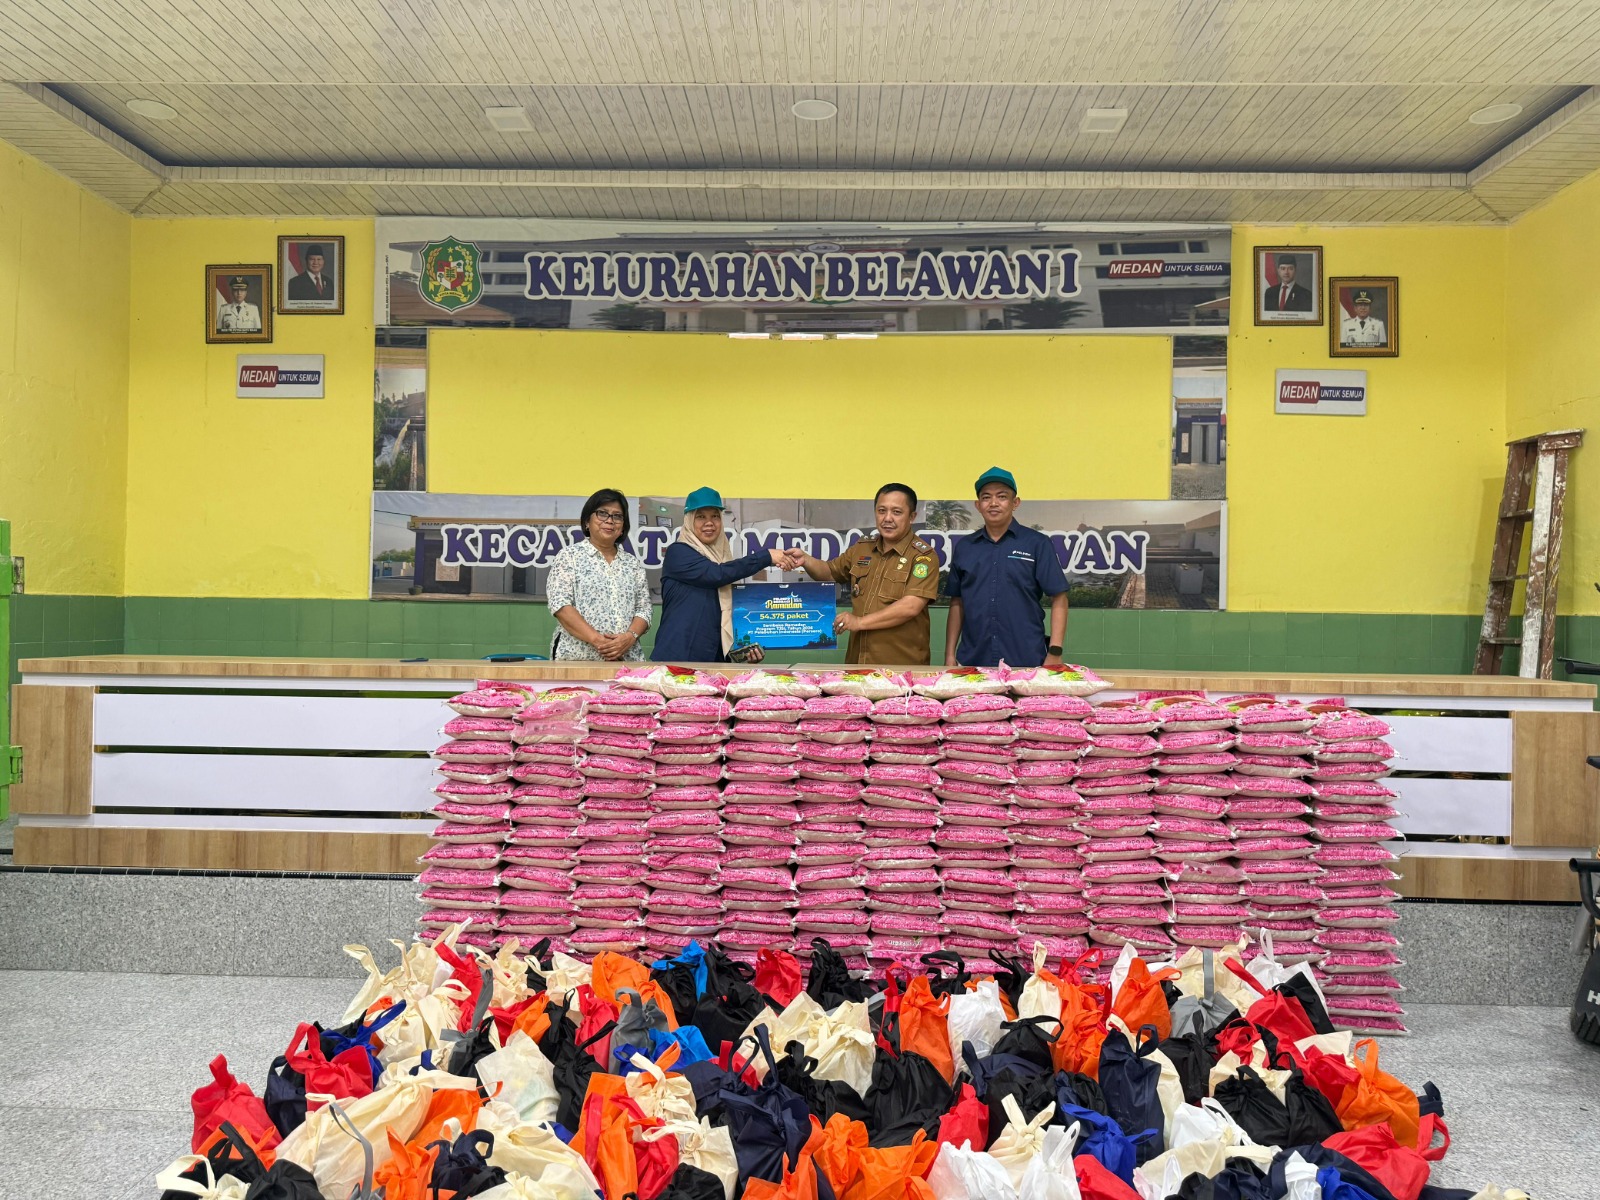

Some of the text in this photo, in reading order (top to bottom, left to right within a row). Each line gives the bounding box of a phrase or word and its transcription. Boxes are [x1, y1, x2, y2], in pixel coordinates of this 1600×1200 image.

[1109, 262, 1163, 275] MEDAN
[1194, 264, 1224, 272] SEMUA
[525, 252, 1079, 299] KELURAHAN BELAWAN I
[241, 370, 319, 383] MEDAN UNTUK SEMUA
[1281, 385, 1363, 399] MEDAN UNTUK SEMUA
[765, 598, 803, 610] Ramadan
[786, 612, 809, 620] paket
